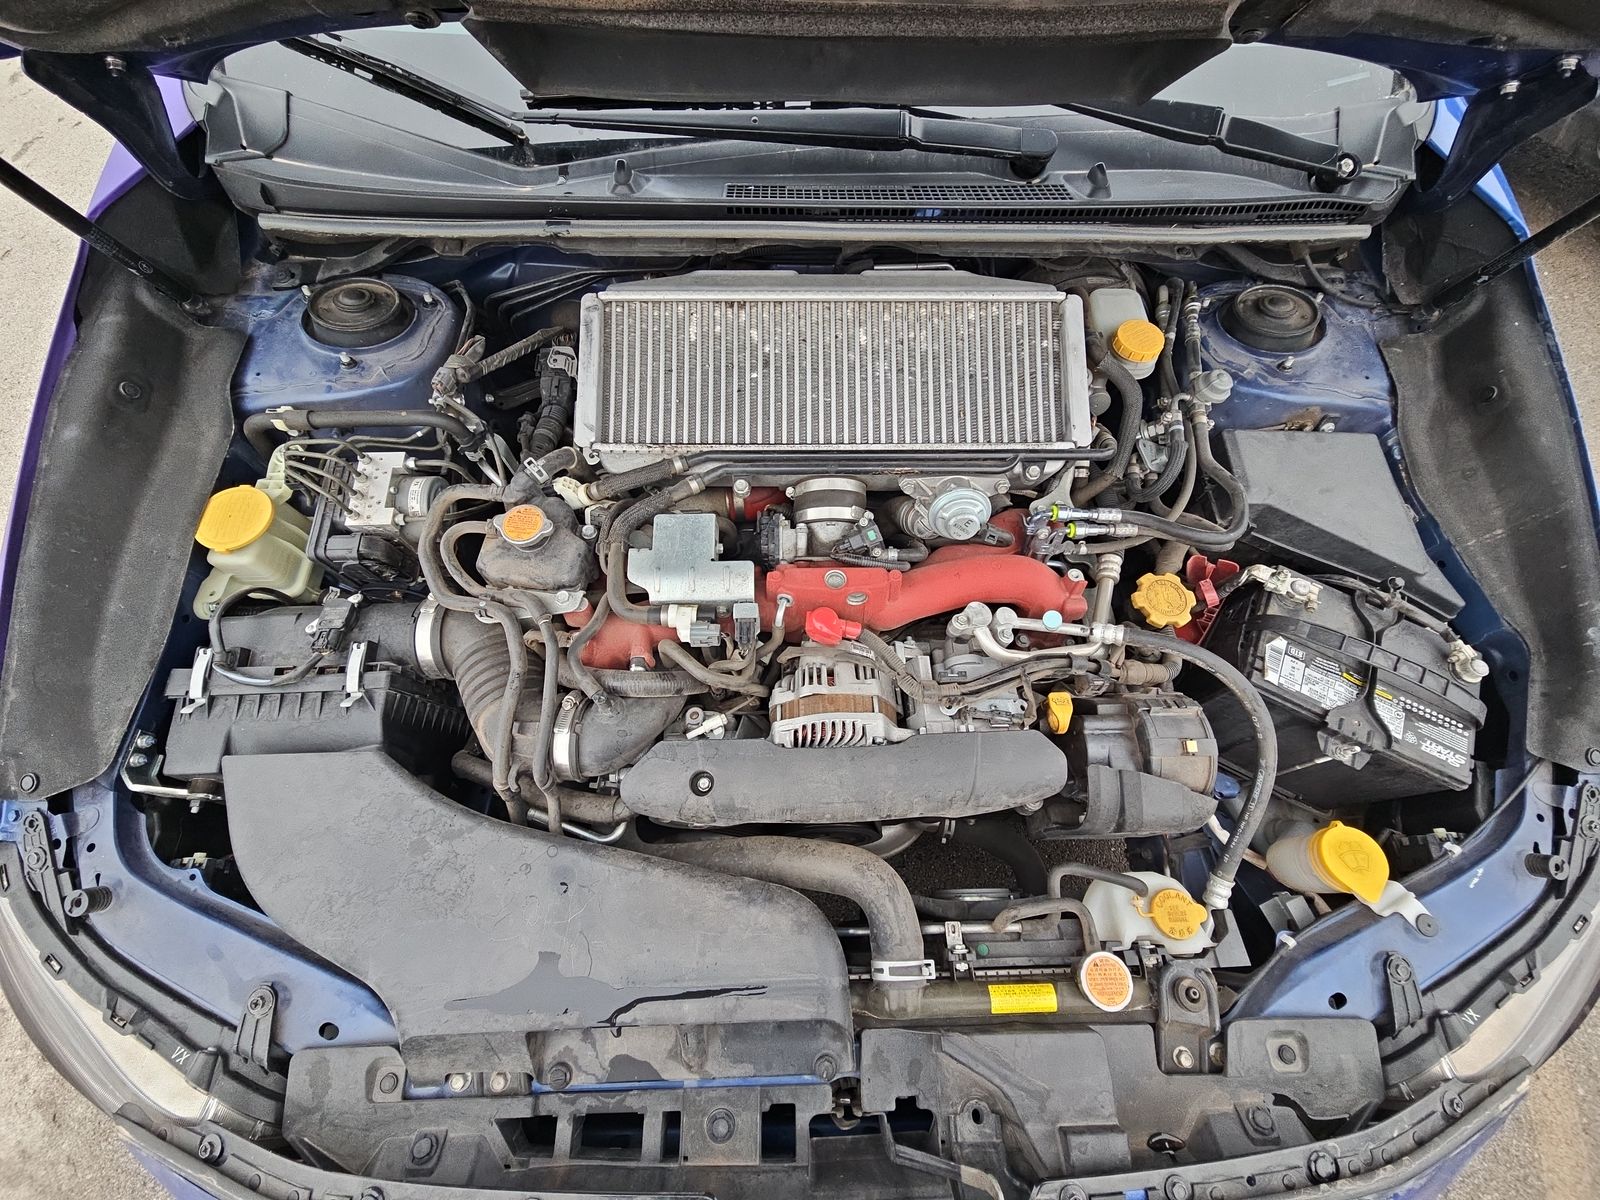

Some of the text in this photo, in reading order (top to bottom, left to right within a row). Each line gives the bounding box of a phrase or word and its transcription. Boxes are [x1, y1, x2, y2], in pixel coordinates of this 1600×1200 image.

[1420, 737, 1467, 764] START
[1421, 743, 1461, 768] SUPER
[1155, 891, 1193, 908] COOLANT
[1461, 1008, 1481, 1025] VX
[171, 1046, 191, 1065] VX
